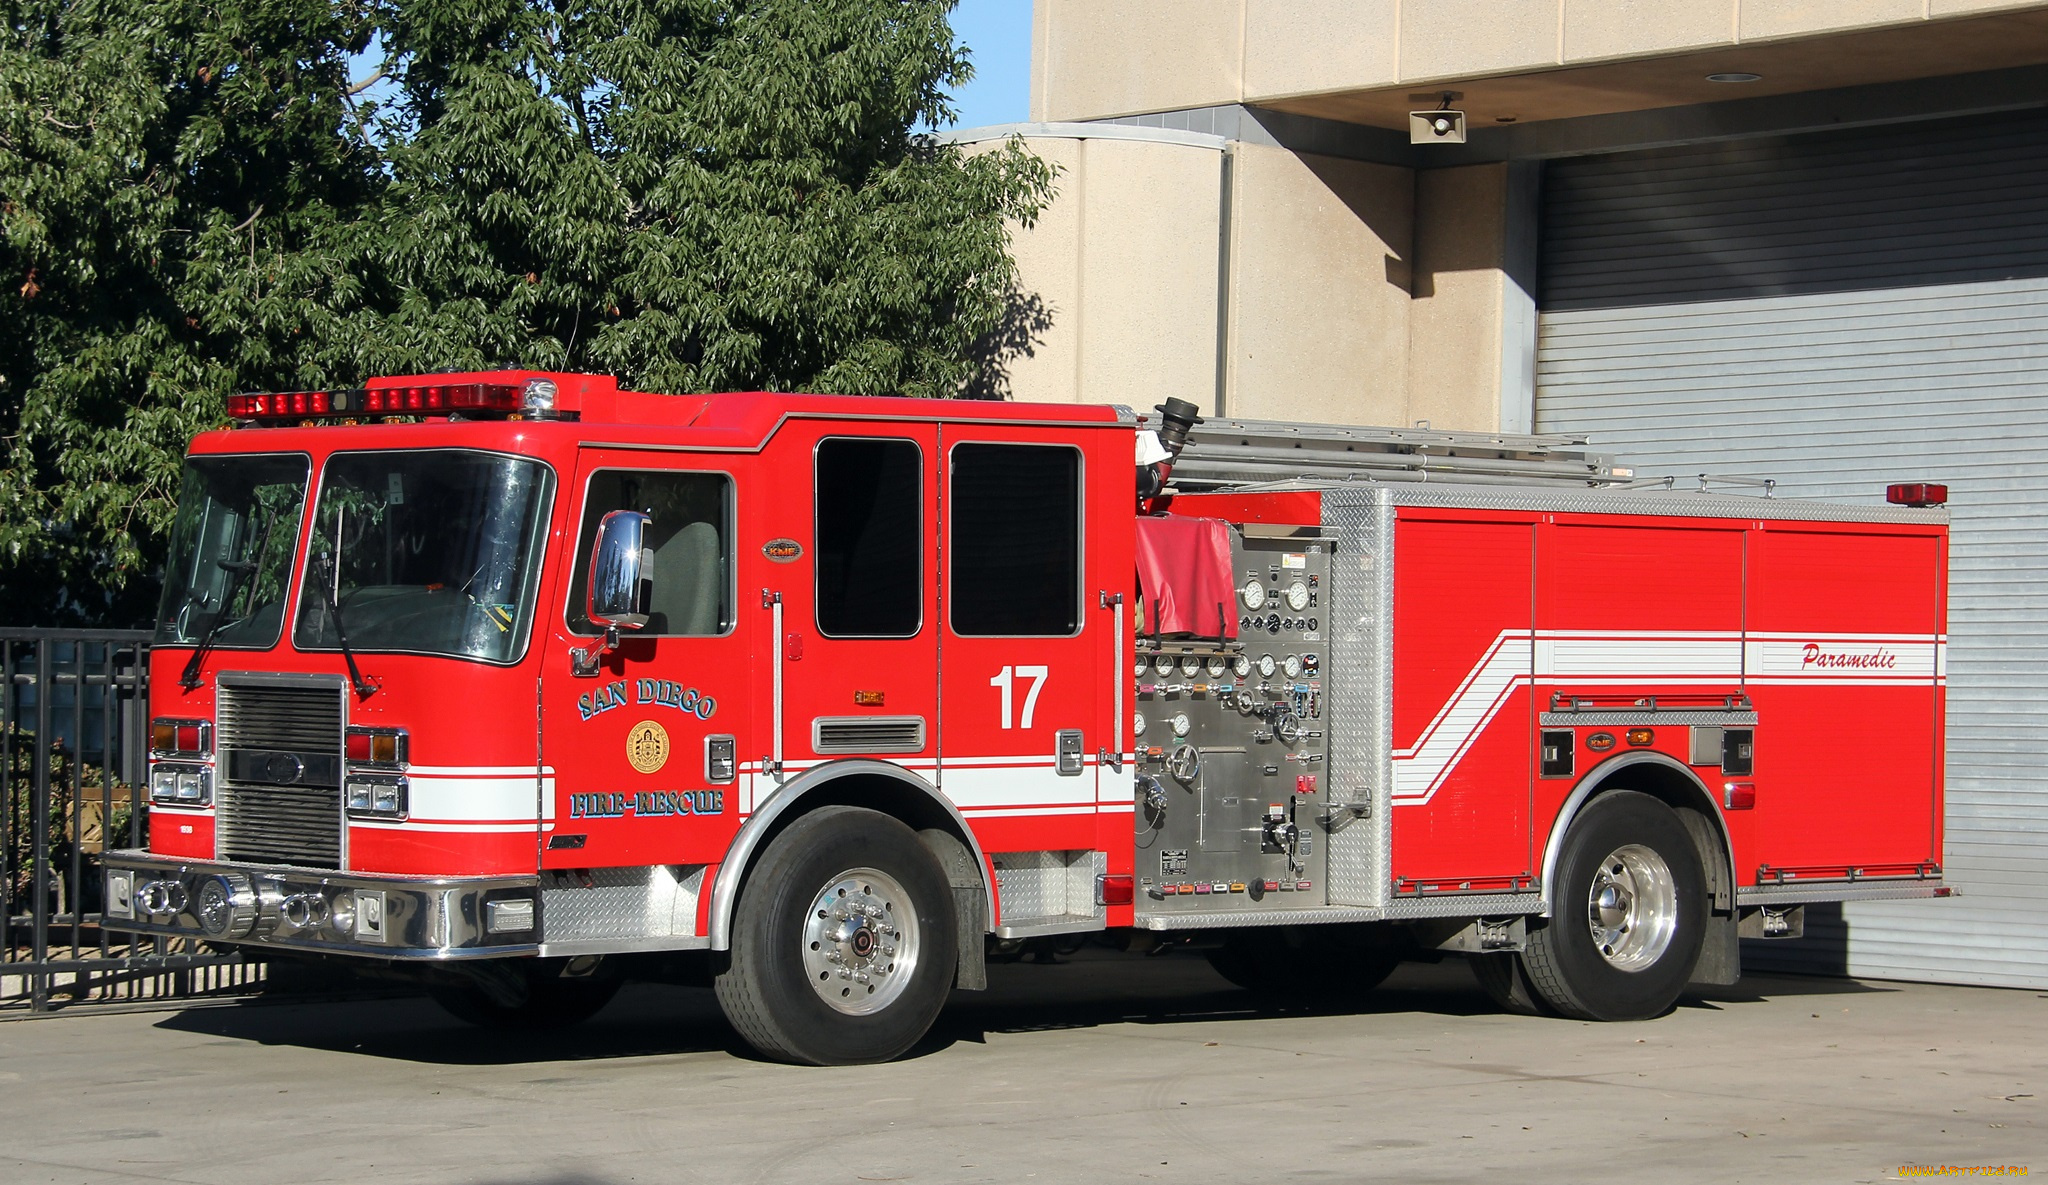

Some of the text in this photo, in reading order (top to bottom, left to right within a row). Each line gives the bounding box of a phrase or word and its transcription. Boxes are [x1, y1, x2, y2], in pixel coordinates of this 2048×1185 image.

[1802, 643, 1896, 670] Paramedic
[578, 677, 718, 721] SAN DIEGO
[990, 665, 1048, 730] 17
[570, 790, 724, 819] FIRE-RESCUE
